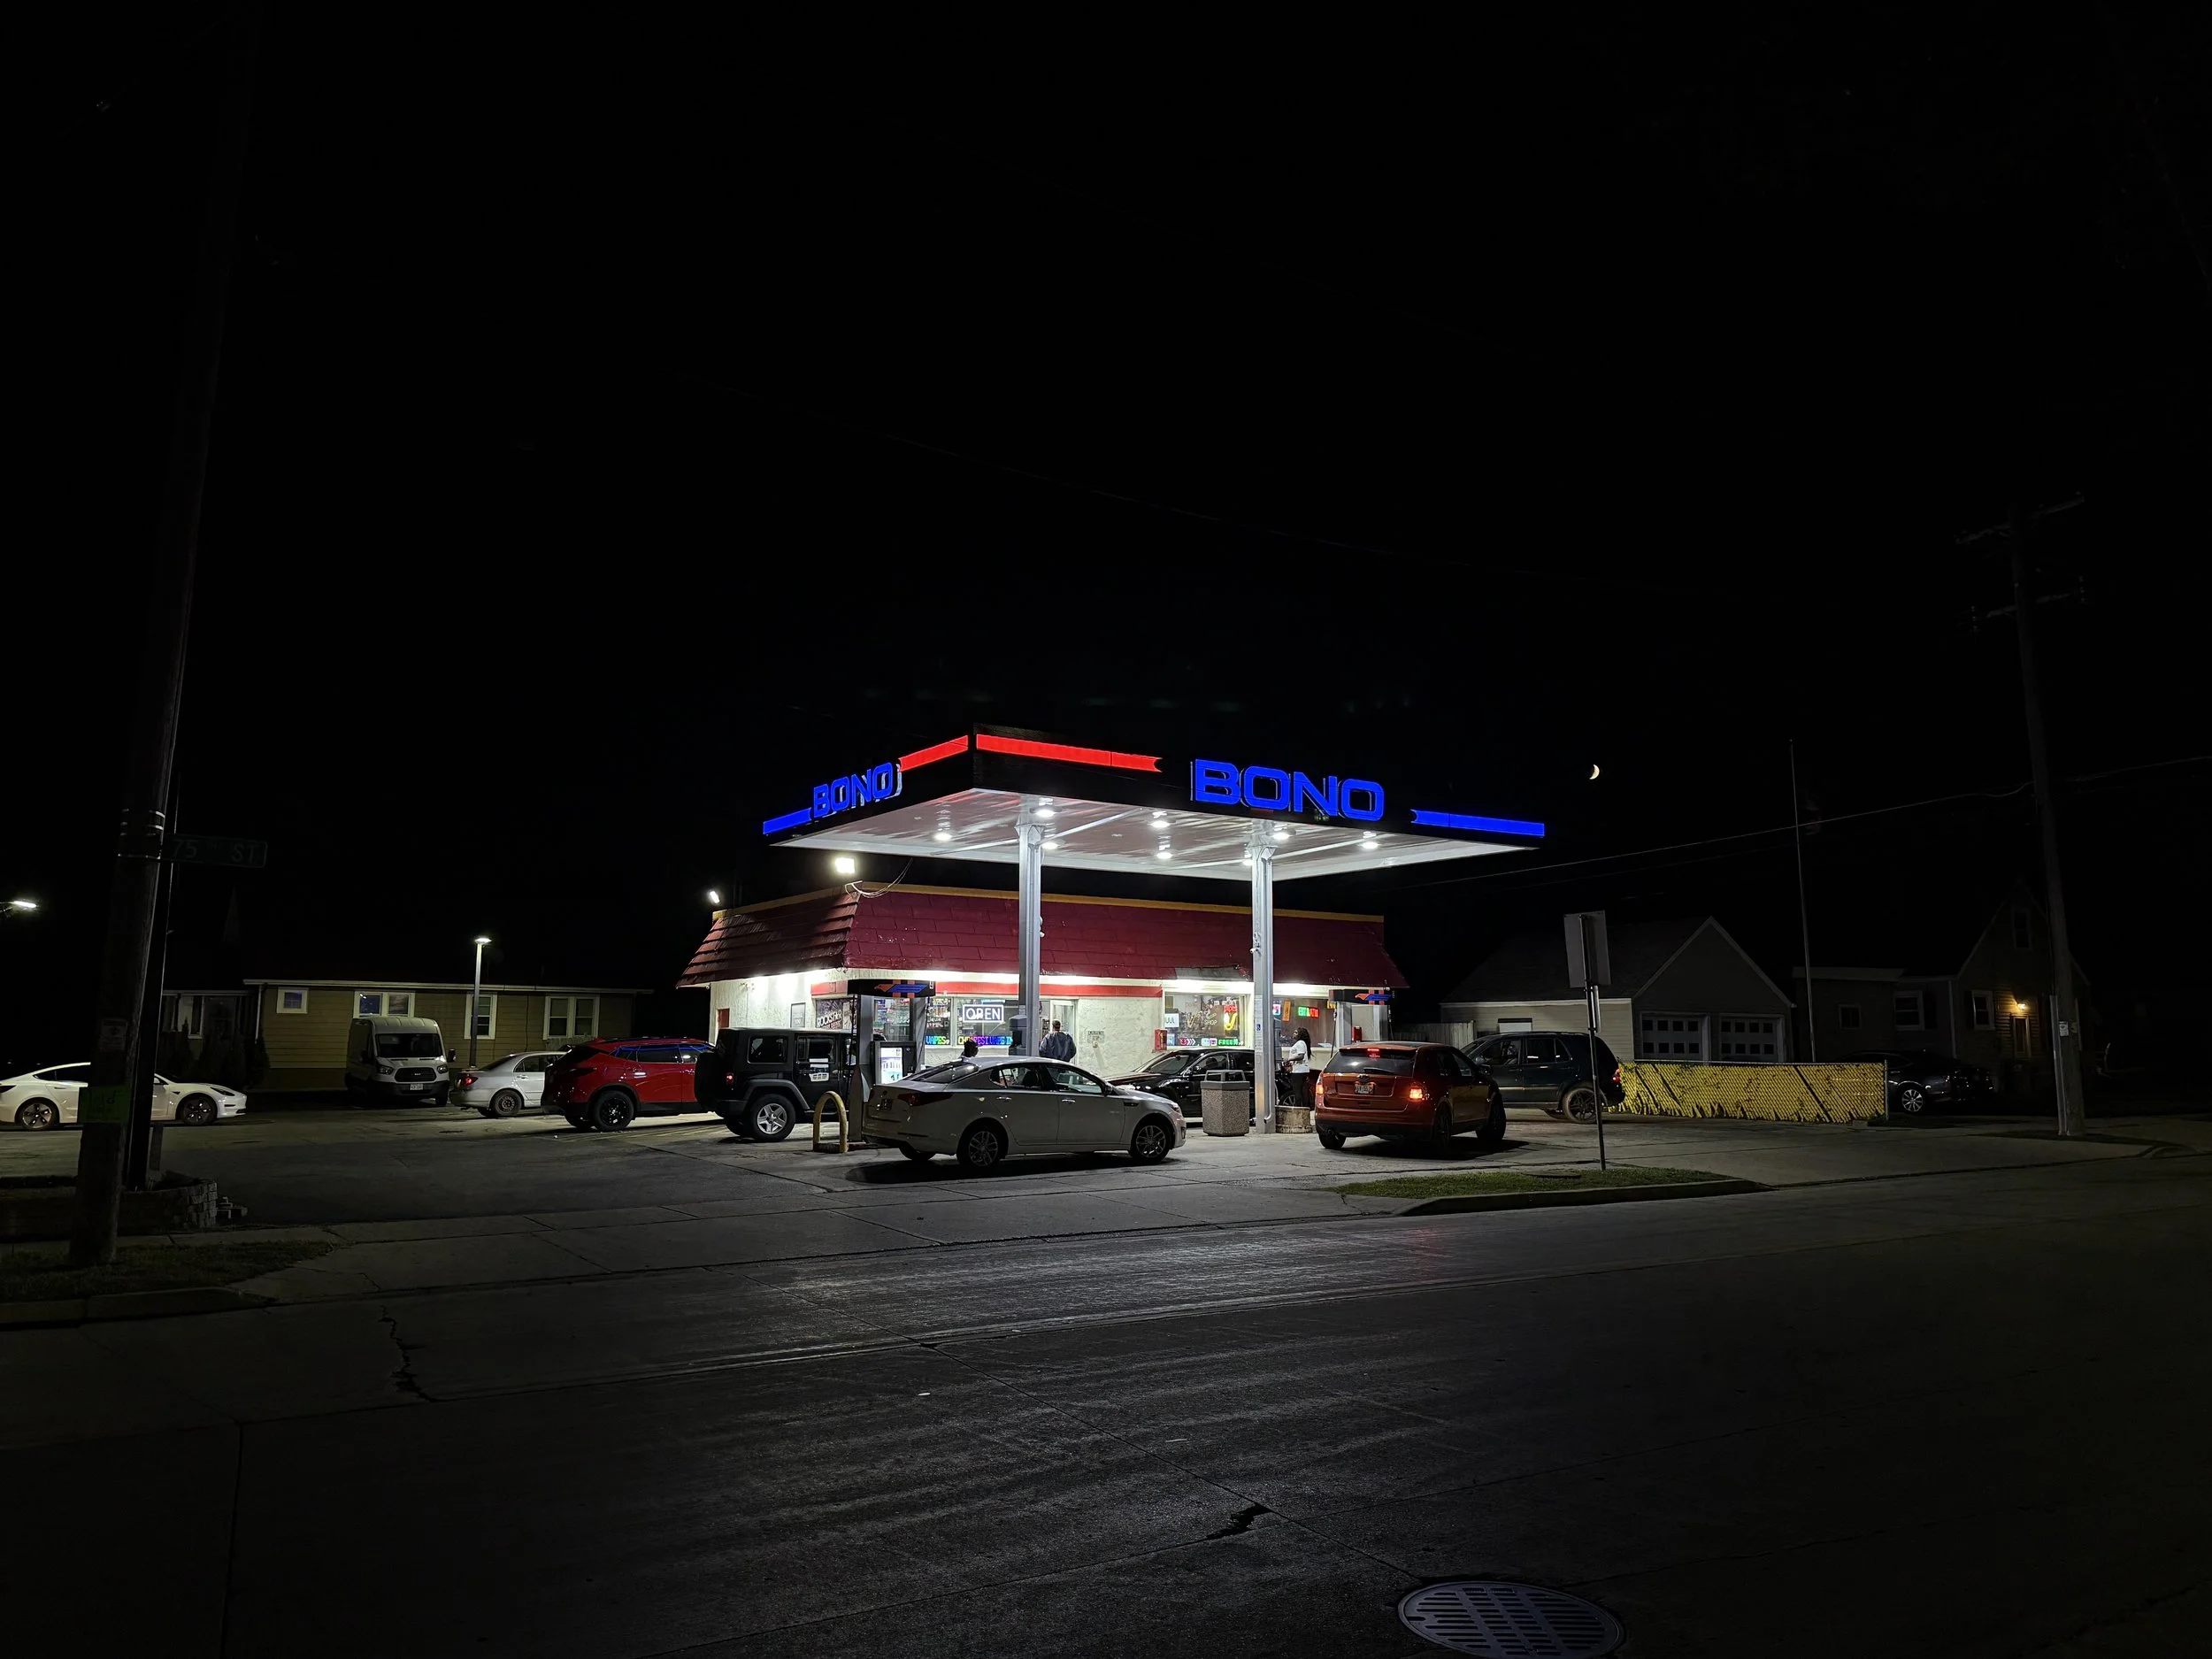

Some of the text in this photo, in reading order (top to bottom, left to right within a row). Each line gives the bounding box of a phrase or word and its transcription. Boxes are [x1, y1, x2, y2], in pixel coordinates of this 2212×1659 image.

[813, 762, 894, 818] BONO
[1194, 758, 1385, 822] BONO
[173, 838, 199, 859] 75
[231, 841, 261, 864] ST
[965, 1007, 1001, 1020] OPEN
